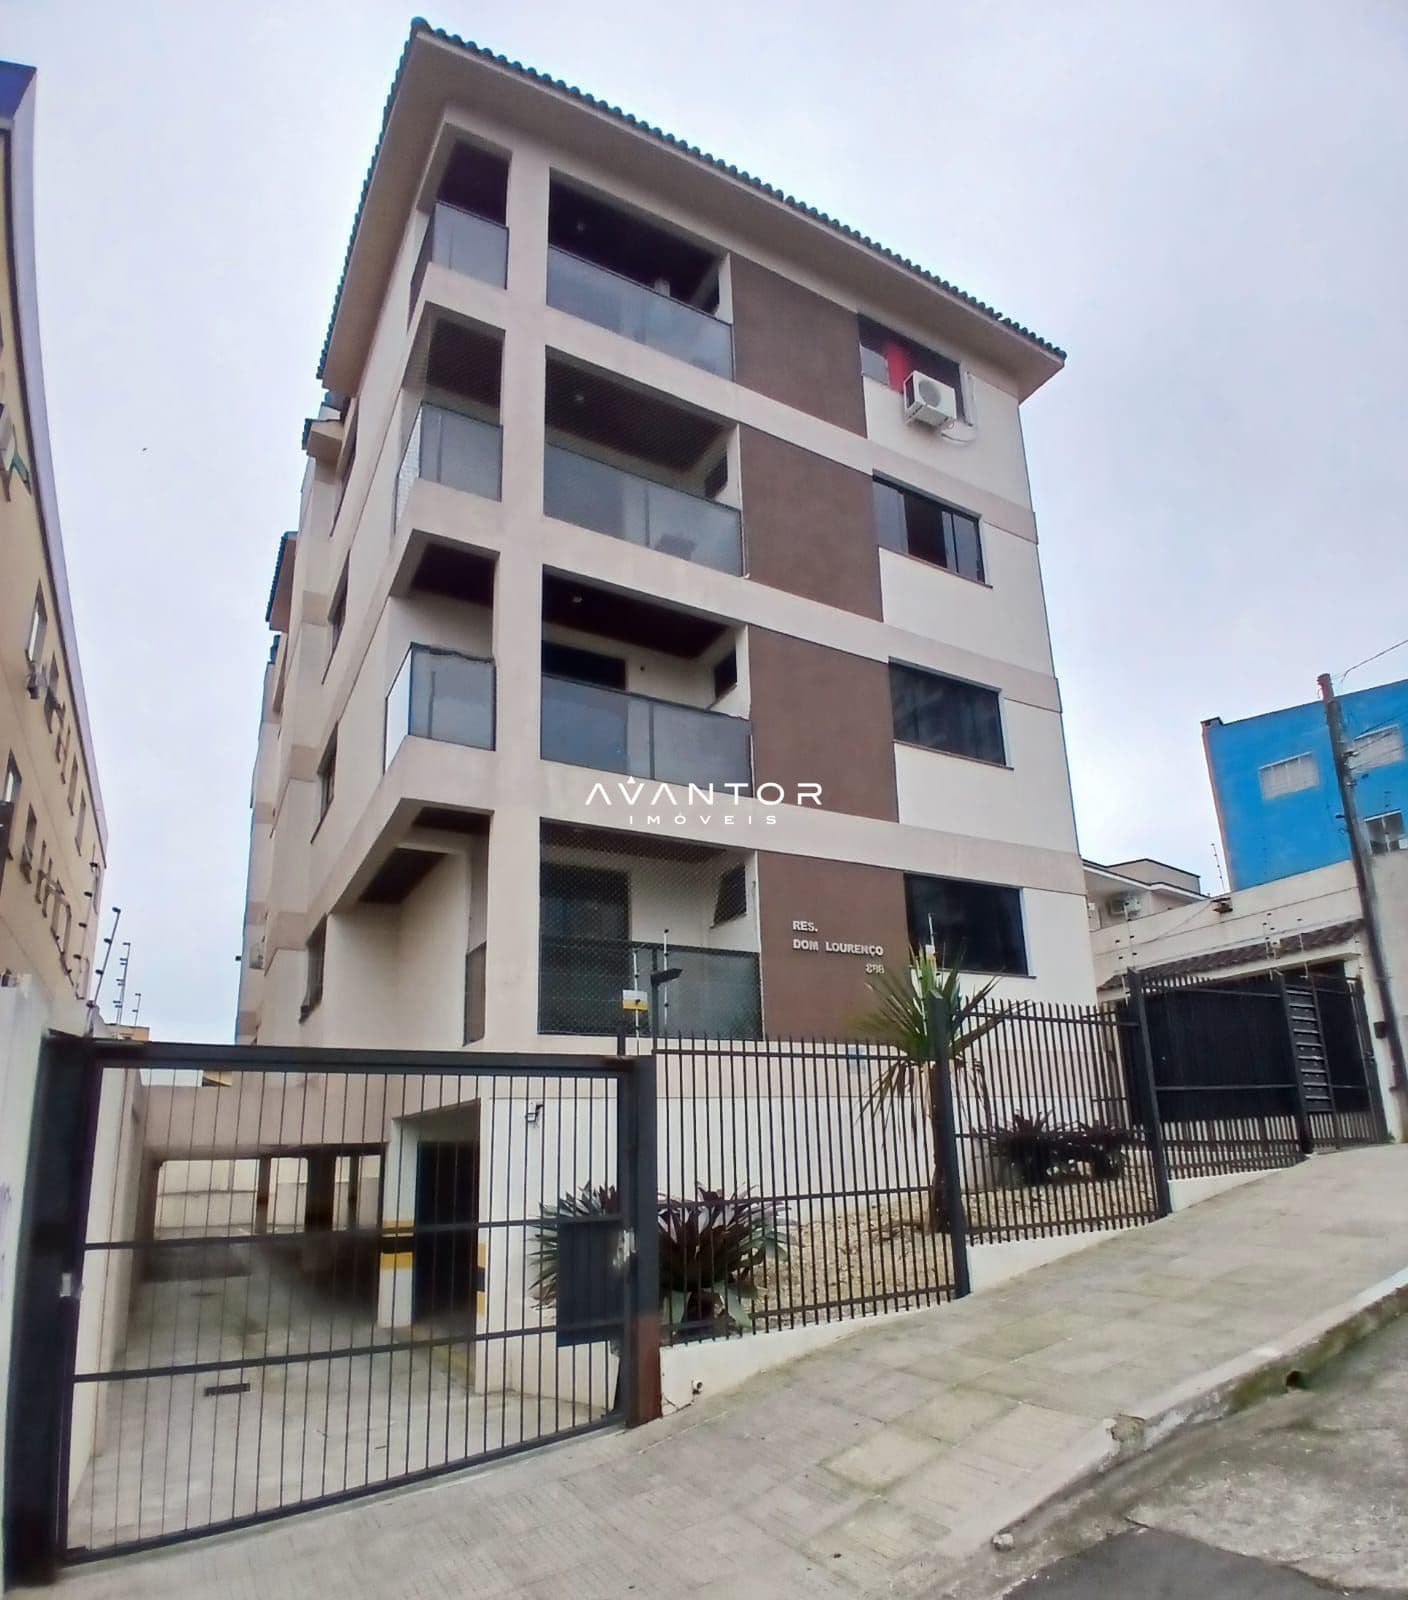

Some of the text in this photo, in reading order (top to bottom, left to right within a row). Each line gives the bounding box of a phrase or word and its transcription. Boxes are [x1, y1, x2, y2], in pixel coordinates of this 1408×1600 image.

[792, 920, 818, 932] RES.
[792, 938, 884, 957] DOM LOURENÇO
